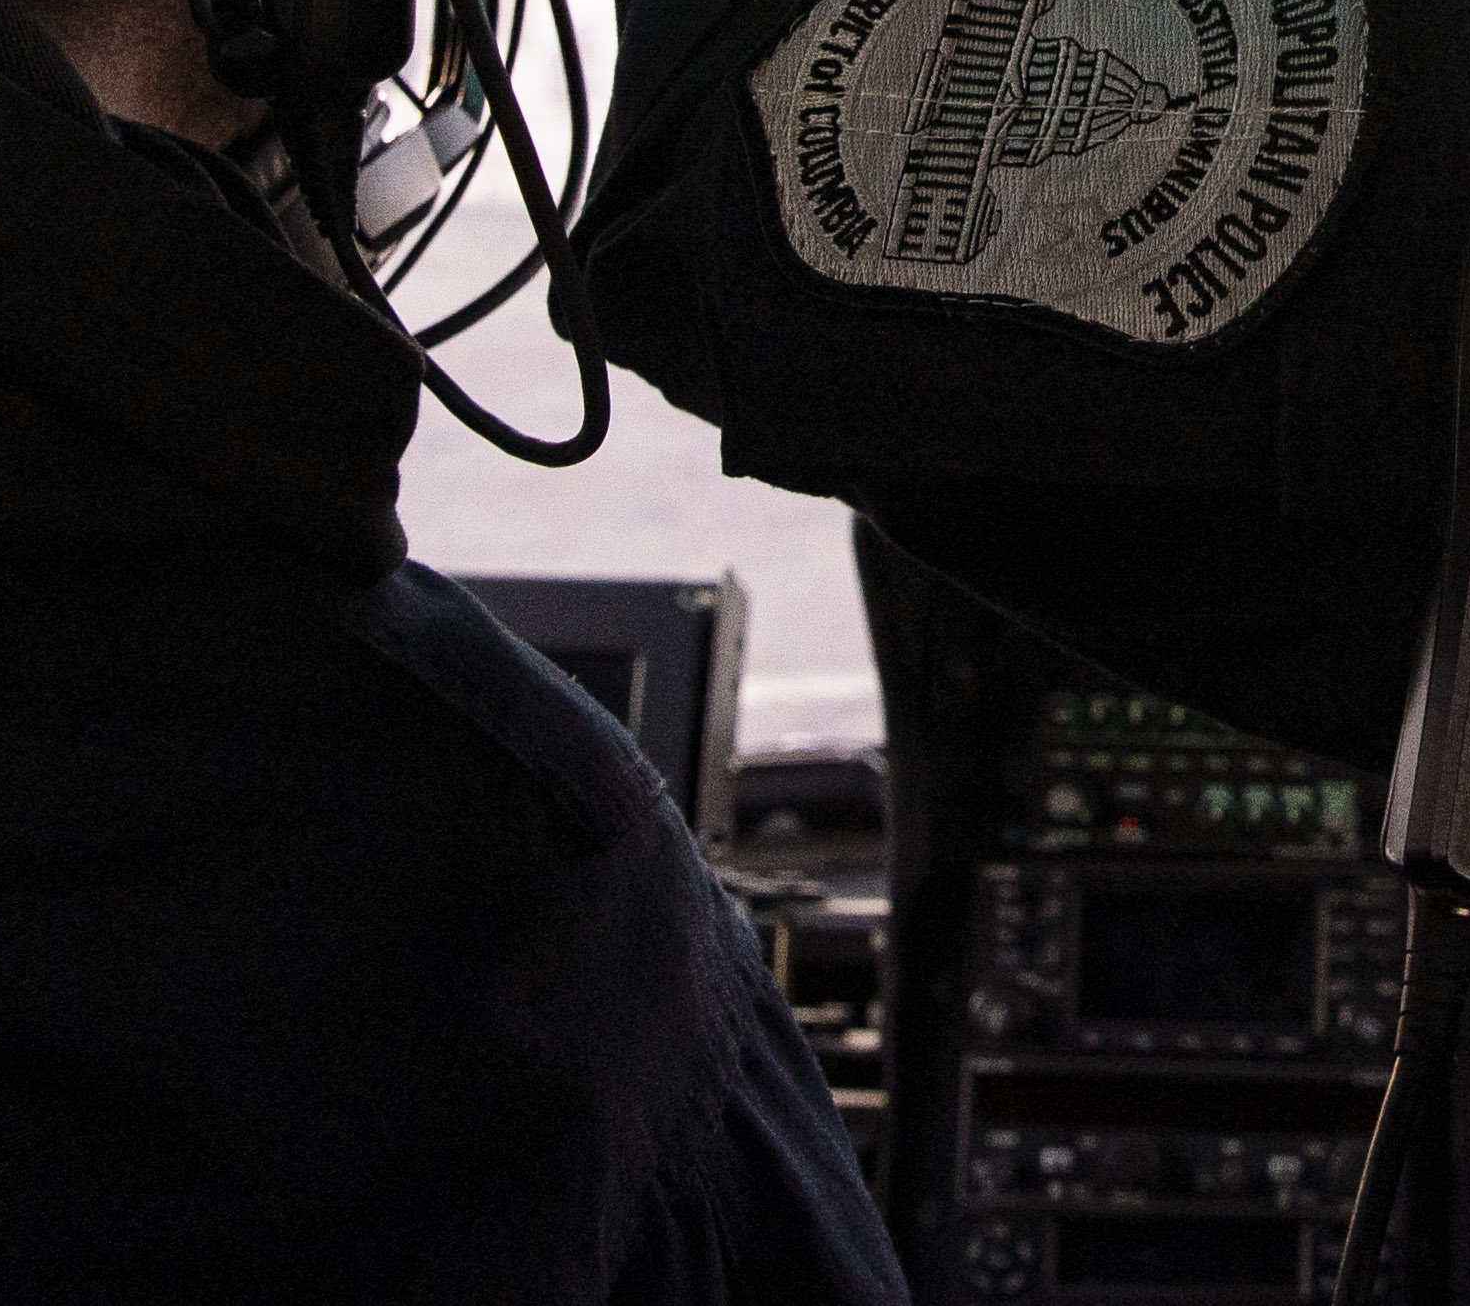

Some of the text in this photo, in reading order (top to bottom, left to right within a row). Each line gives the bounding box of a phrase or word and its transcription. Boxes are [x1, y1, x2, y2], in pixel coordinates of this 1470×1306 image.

[798, 104, 878, 260] COLUMBIA
[1102, 105, 1230, 256] OMNIBUS
[1142, 190, 1291, 337] POLICE
